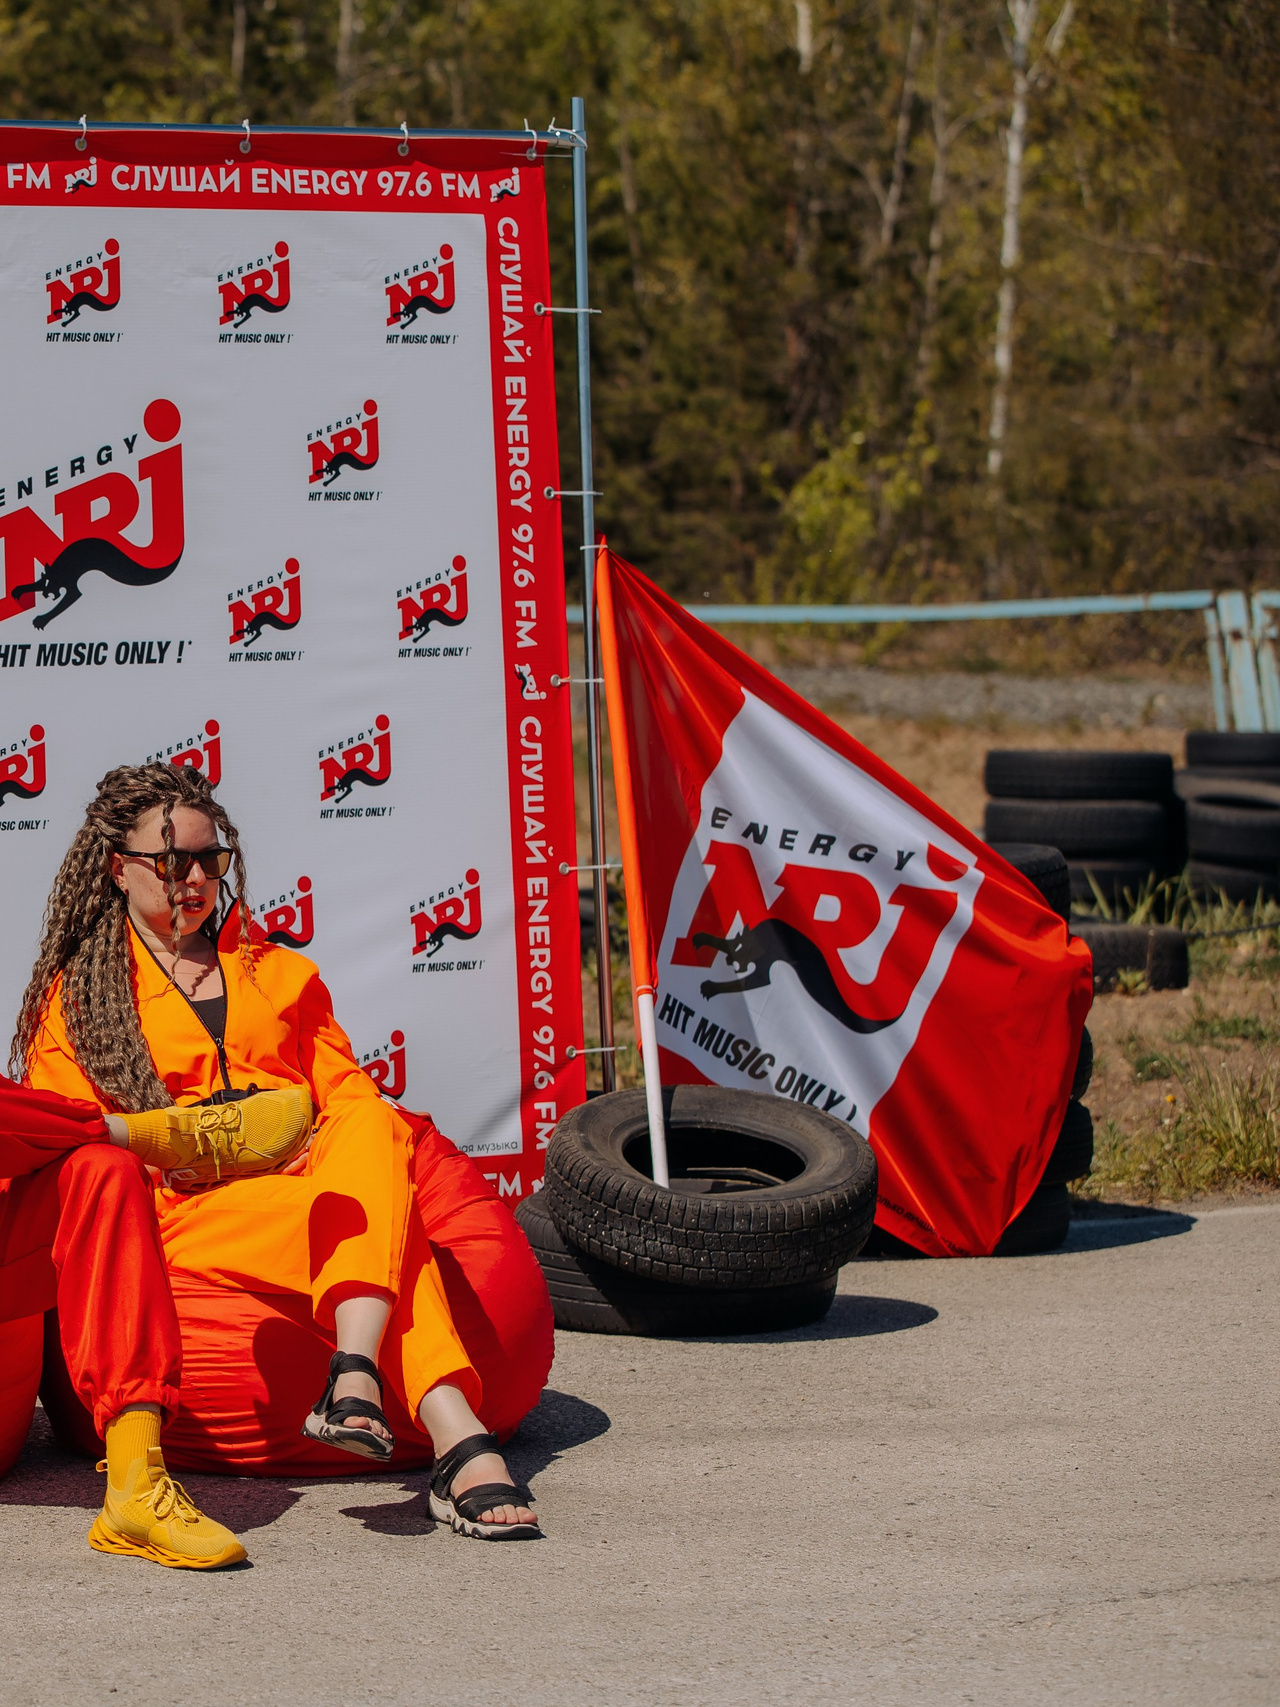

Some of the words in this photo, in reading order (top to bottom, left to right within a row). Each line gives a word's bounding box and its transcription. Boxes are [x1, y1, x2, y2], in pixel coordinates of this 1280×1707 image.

[6, 162, 52, 190] FM
[111, 158, 241, 193] СЛУШАЙ
[251, 167, 369, 196] ENERGY
[376, 170, 433, 197] 97.6
[440, 172, 481, 199] FM
[45, 251, 103, 281] ENERGY
[217, 254, 273, 283] ENERGY
[384, 256, 438, 285] ENERGY
[497, 216, 532, 364] СЛУШАЙ
[45, 332, 61, 342] HIT
[62, 332, 91, 343] MUSIC
[92, 332, 116, 343] ONLY
[218, 333, 233, 343] HIT
[234, 333, 262, 344] MUSIC
[263, 333, 286, 344] ONLY
[385, 334, 400, 344] HIT
[401, 334, 428, 344] MUSIC
[429, 334, 451, 345] ONLY
[307, 412, 362, 442] ENERGY
[504, 375, 533, 514] ENERGY
[308, 491, 323, 502] HIT
[323, 491, 352, 502] MUSIC
[353, 491, 375, 501] ONLY
[511, 523, 536, 588] 97.6
[227, 571, 283, 602] ENERGY
[396, 569, 450, 598] ENERGY
[514, 599, 538, 649] FM
[35, 641, 109, 667] MUSIC
[114, 640, 172, 666] ONLY
[228, 652, 244, 662] HIT
[244, 651, 273, 662] MUSIC
[274, 651, 297, 661] ONLY
[398, 648, 413, 658] HIT
[413, 647, 441, 658] MUSIC
[442, 647, 464, 657] ONLY
[318, 728, 373, 759] ENERGY
[519, 715, 554, 864] СЛУШАЙ
[17, 820, 41, 831] ONLY
[320, 809, 335, 819] HIT
[335, 807, 364, 819] MUSIC
[365, 807, 387, 817] ONLY
[710, 806, 915, 872] ENERGY
[409, 882, 464, 913] ENERGY
[526, 876, 554, 1015] ENERGY
[412, 963, 426, 973] HIT
[427, 961, 455, 972] MUSIC
[456, 960, 477, 971] ONLY
[657, 993, 696, 1035] HIT
[692, 1016, 776, 1080] MUSIC
[532, 1025, 556, 1091] 97.6
[533, 1101, 557, 1150] FM
[476, 1140, 519, 1154] музыка
